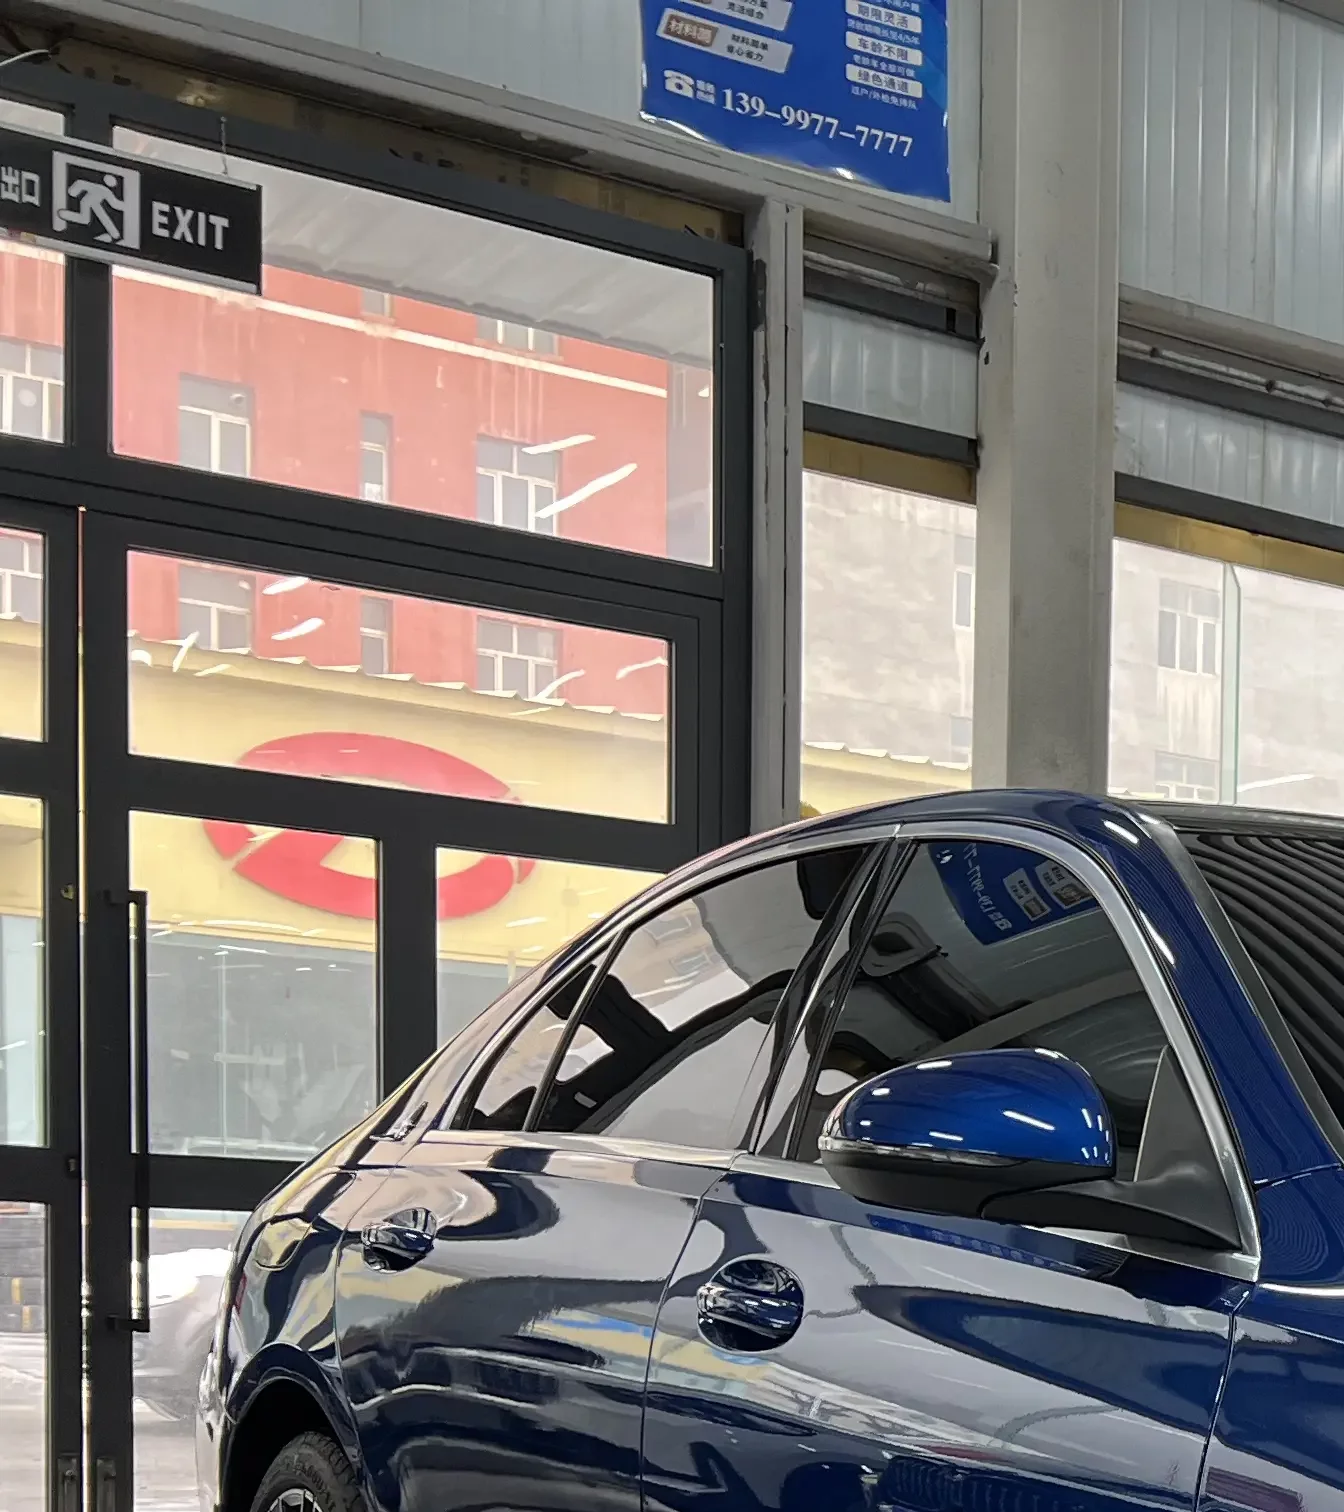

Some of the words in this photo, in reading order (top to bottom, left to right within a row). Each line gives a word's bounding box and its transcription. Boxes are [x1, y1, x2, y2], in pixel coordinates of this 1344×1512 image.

[857, 4, 908, 29] 期限灵活
[857, 37, 908, 62] 车龄不限
[857, 71, 909, 94] 绿色通道
[0, 166, 41, 207] 出口
[151, 200, 230, 250] EXIT
